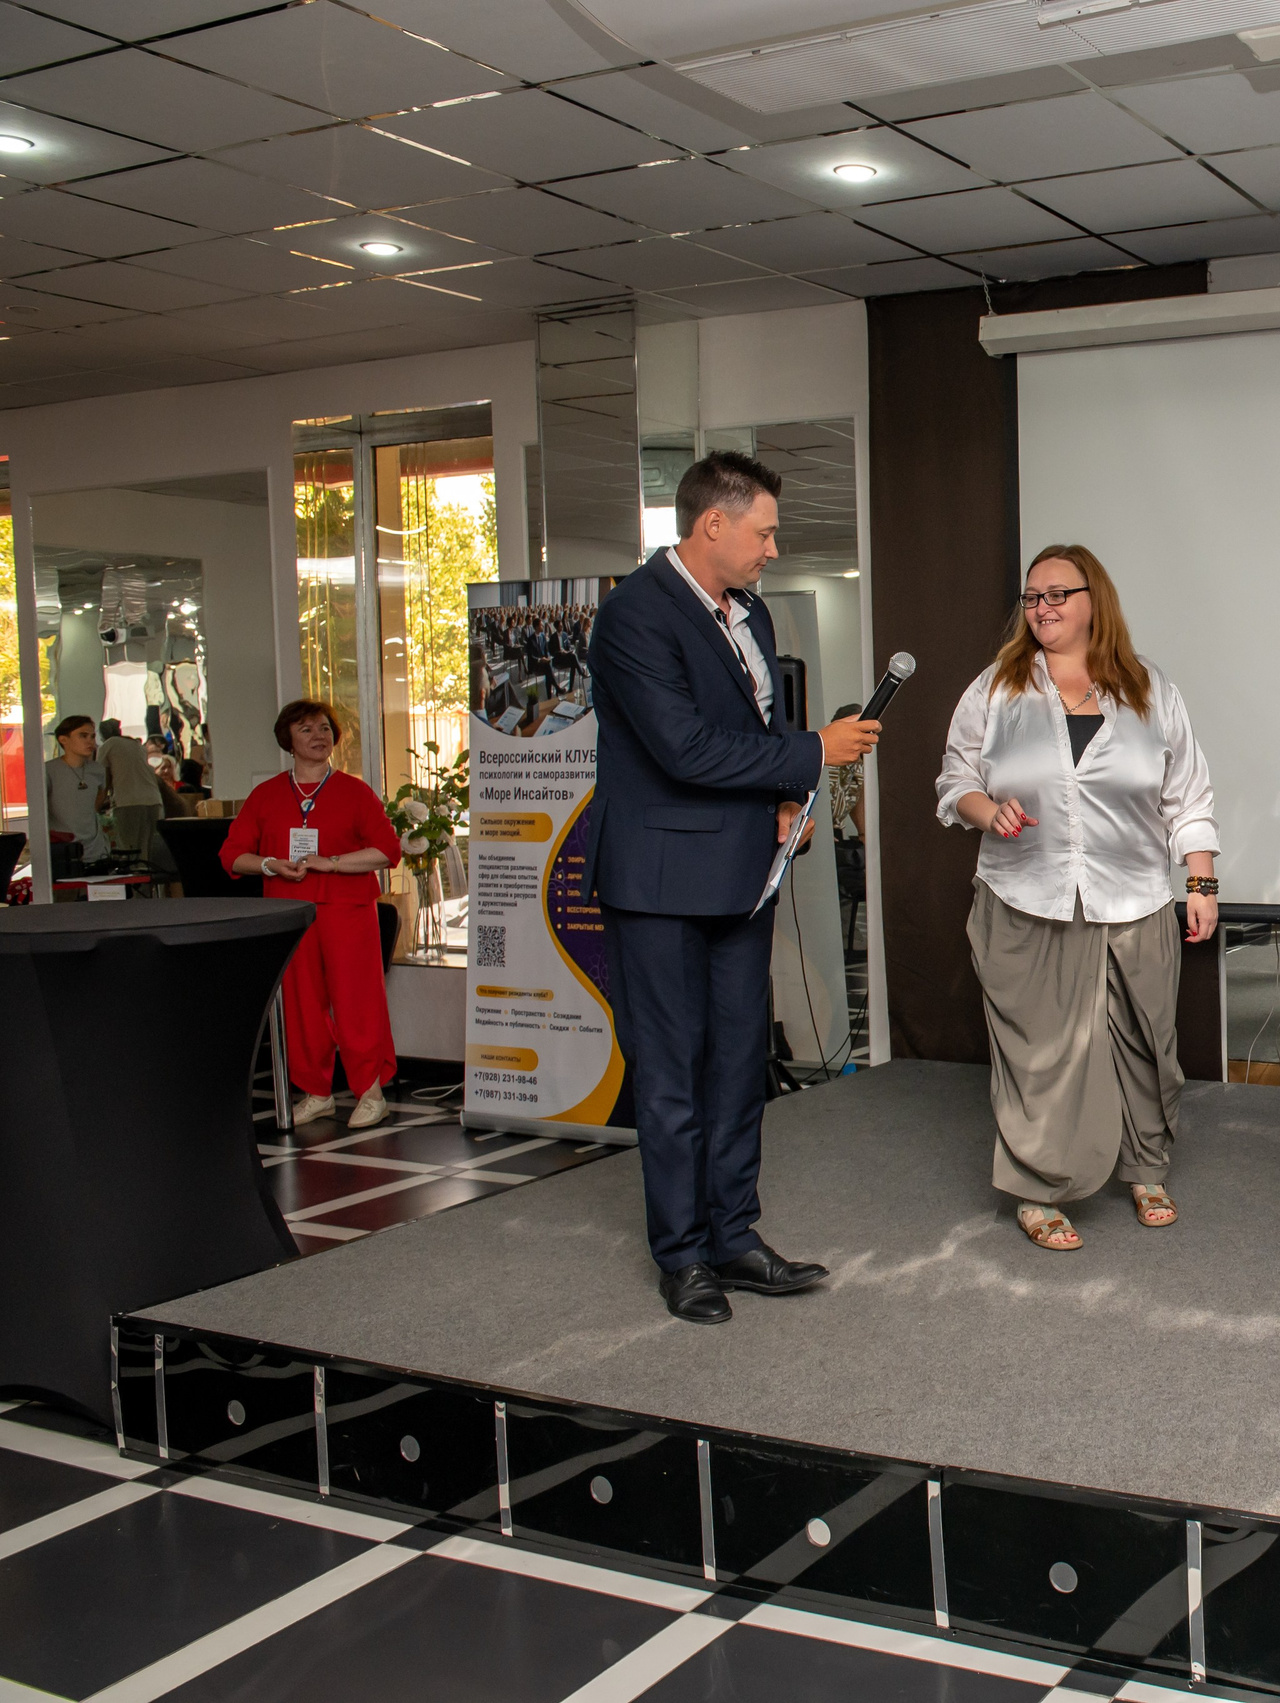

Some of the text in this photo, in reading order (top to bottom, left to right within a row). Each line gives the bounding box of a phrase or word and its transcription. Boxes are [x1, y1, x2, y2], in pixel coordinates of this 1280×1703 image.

[479, 749, 597, 767] Всероссийский КЛУБ
[479, 770, 596, 781] психологии и саморазвития
[479, 786, 575, 803] «Море Инсайтов»
[480, 817, 536, 827] Сильное окружение
[475, 1005, 582, 1020] Окружение Пространство Созидание
[475, 1018, 504, 1027] Медийность
[509, 1021, 540, 1029] публичность
[549, 1023, 570, 1032] Скидки
[578, 1025, 603, 1034] События
[474, 1071, 501, 1083] +7(928)
[474, 1088, 502, 1101] +7(987)
